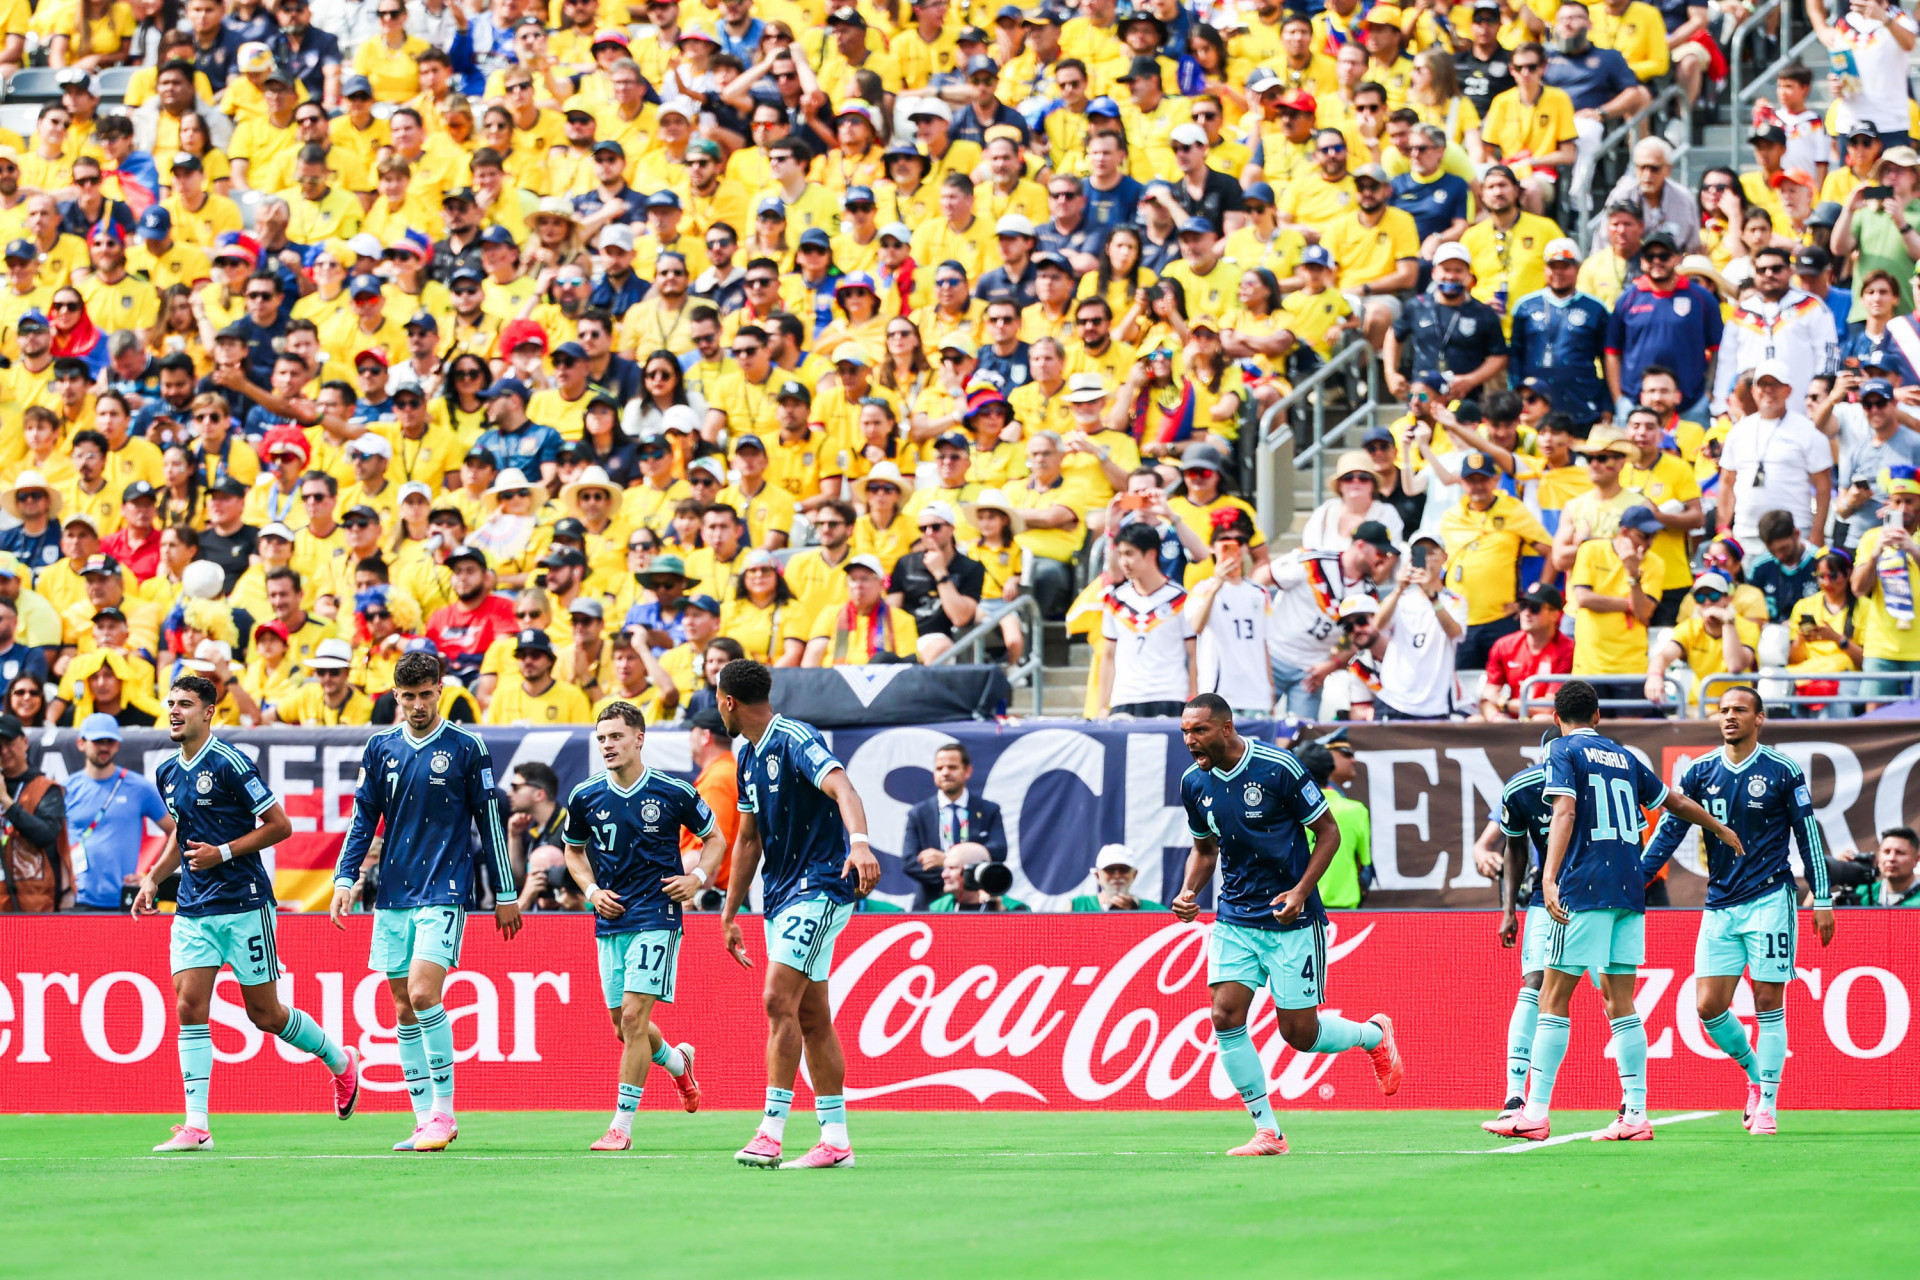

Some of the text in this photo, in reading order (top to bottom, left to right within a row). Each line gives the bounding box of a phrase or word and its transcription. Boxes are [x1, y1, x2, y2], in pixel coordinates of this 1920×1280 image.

[1233, 618, 1254, 640] 13
[1307, 617, 1334, 641] 13
[1136, 636, 1146, 656] 7
[1583, 747, 1630, 770] MUSIALA
[386, 772, 401, 798] 7
[1588, 773, 1640, 846] 10
[591, 823, 618, 851] 17
[441, 910, 456, 935] 7
[782, 915, 818, 947] 23
[248, 935, 264, 963] 5
[638, 943, 666, 972] 17
[1766, 932, 1789, 959] 19
[1301, 954, 1315, 982] 4
[208, 970, 571, 1093] sugar
[1513, 1046, 1529, 1055] DFB
